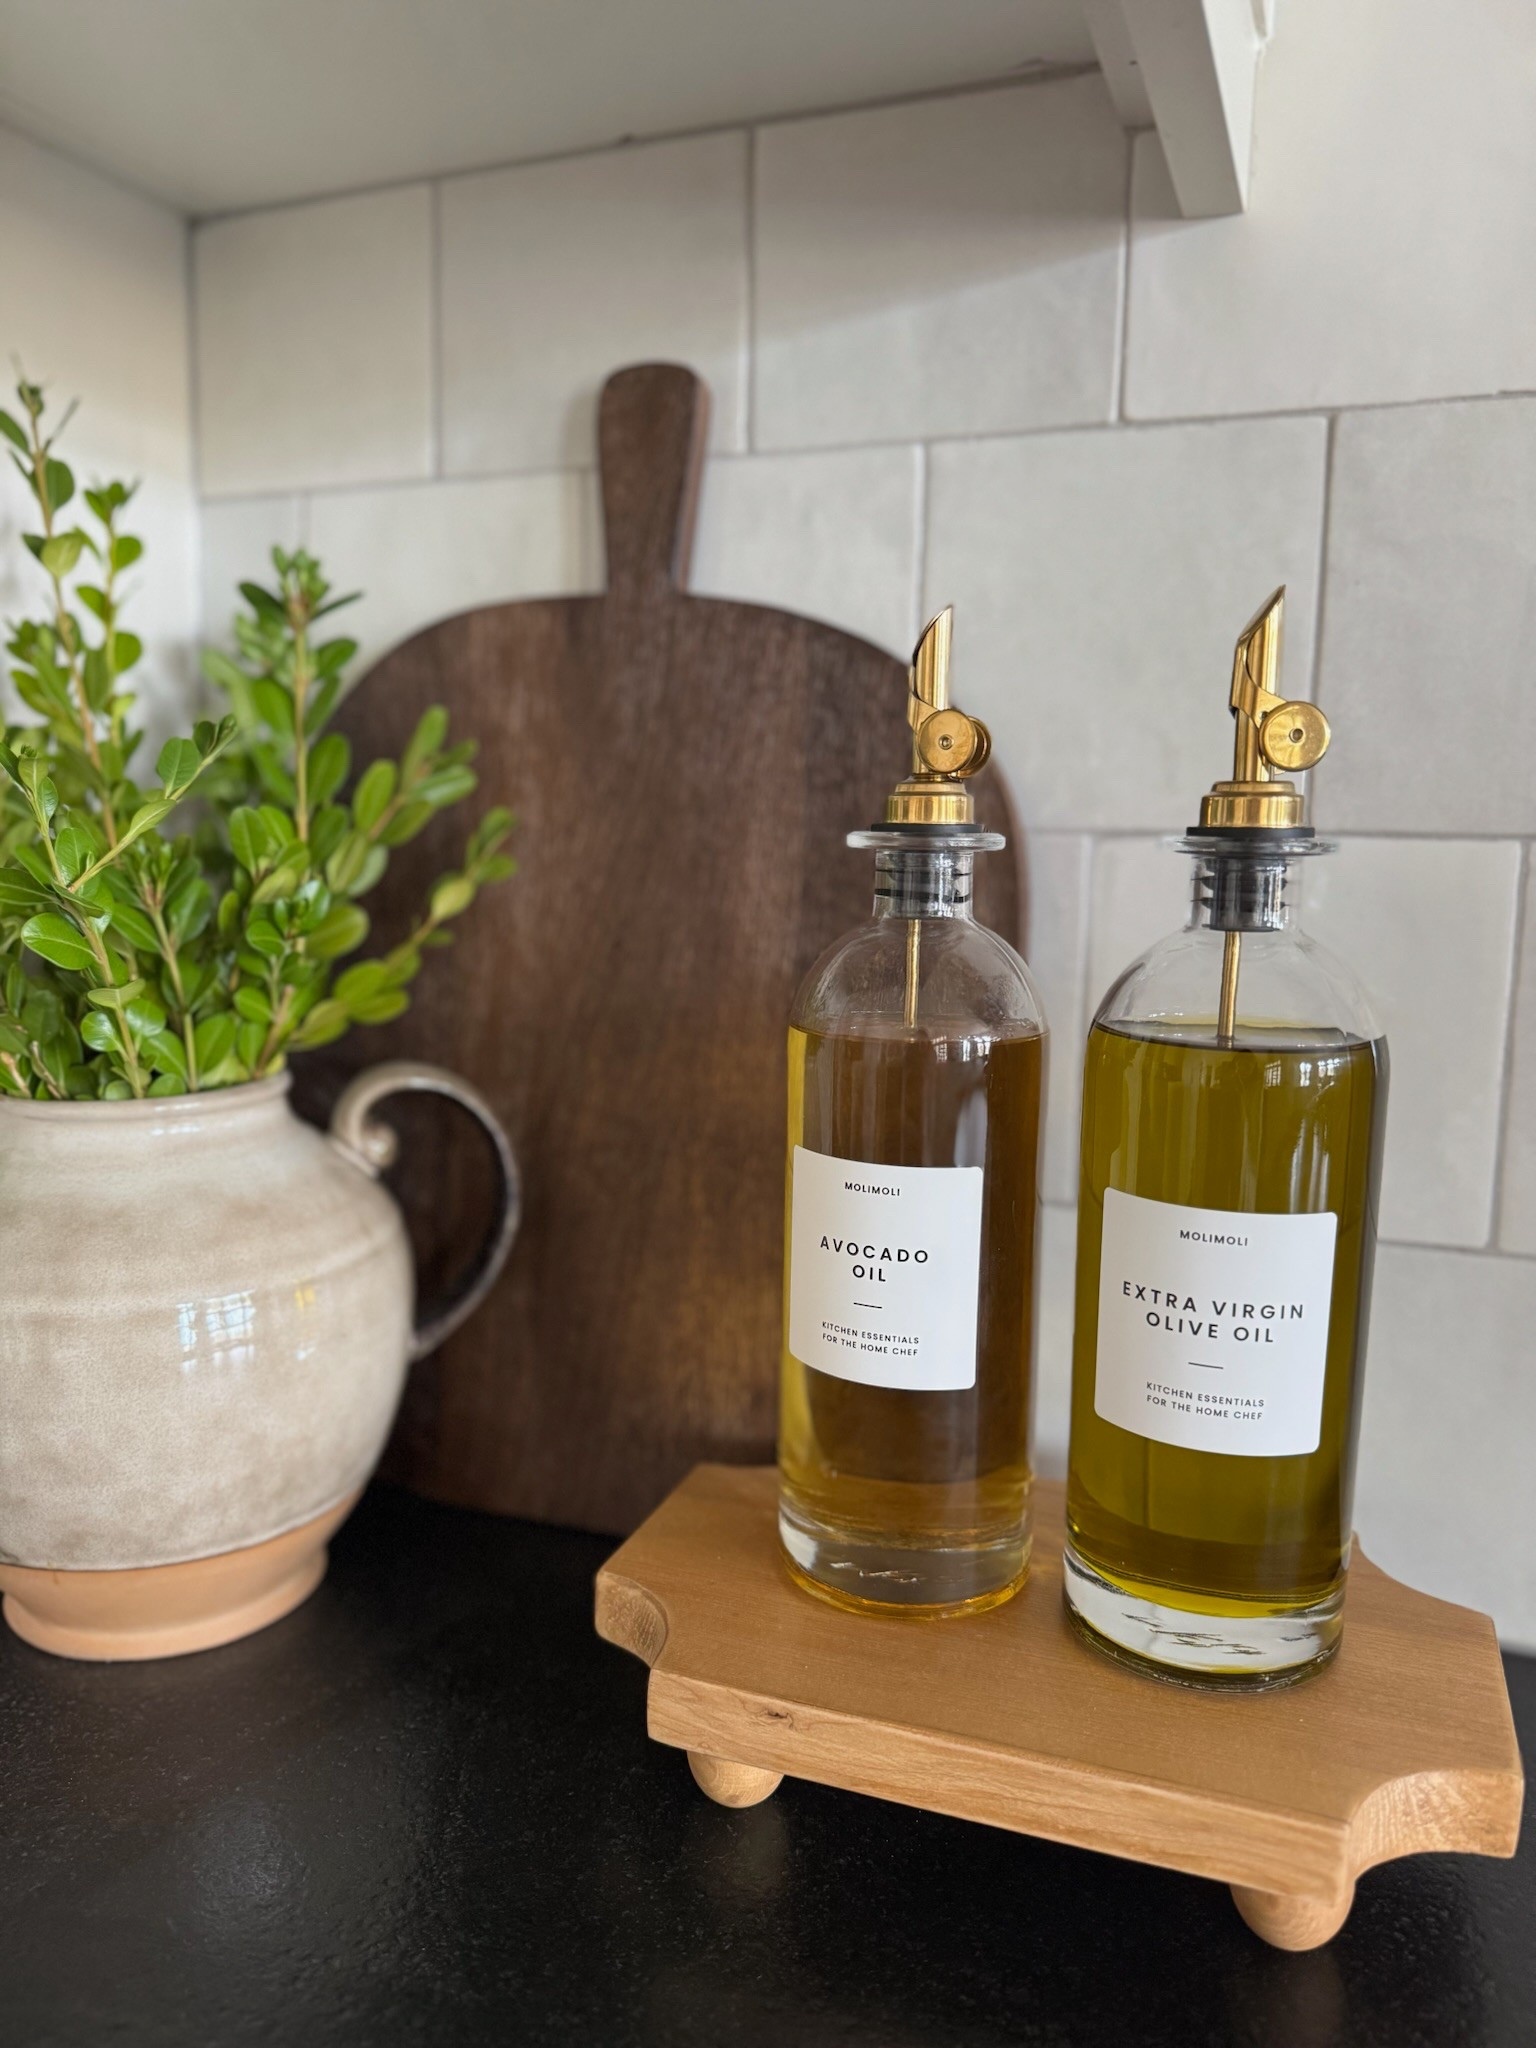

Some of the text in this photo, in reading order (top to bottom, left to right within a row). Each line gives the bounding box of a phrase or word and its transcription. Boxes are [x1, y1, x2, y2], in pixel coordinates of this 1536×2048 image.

[844, 1181, 901, 1197] MOLIMOLI
[819, 1235, 929, 1264] AVOCADO
[1179, 1229, 1249, 1247] MOLIMOLI
[852, 1264, 887, 1283] OIL
[1122, 1280, 1305, 1320] EXTRA VIRGIN
[822, 1321, 920, 1345] KITCHEN ESSENTIALS
[1145, 1311, 1274, 1343] OLIVE OIL
[822, 1332, 919, 1357] FOR THE HOME CHEF
[1146, 1381, 1265, 1408] KITCHEN ESSENTIALS
[1146, 1394, 1264, 1421] FOR THE HOME CHEF
